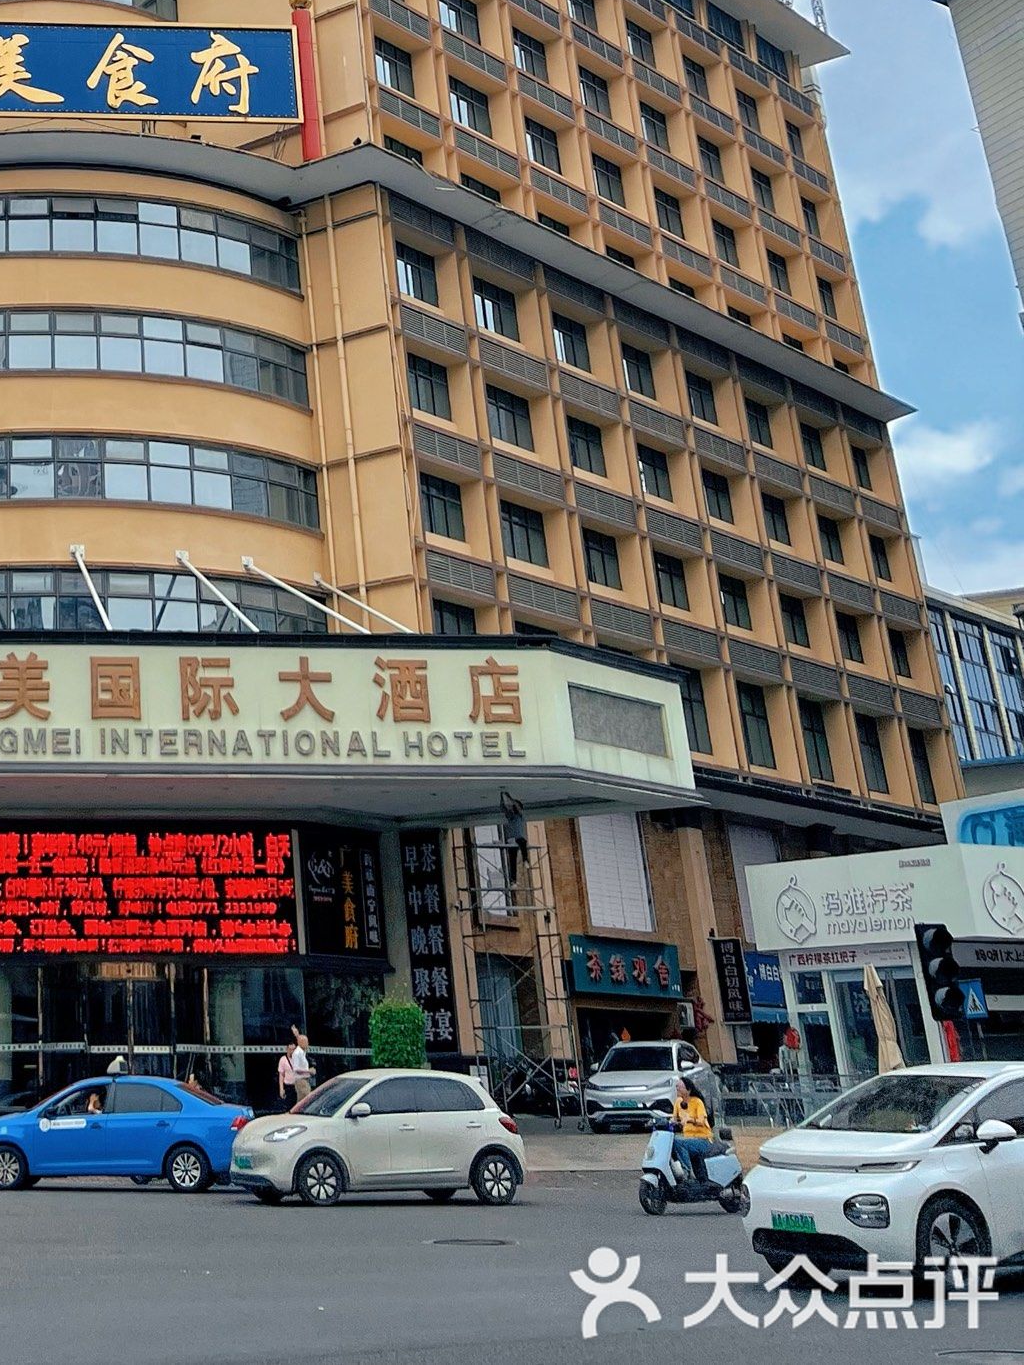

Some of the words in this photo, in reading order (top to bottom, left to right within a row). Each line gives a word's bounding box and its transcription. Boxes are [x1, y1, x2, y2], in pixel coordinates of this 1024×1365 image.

[99, 727, 391, 758] INTERNATIONAL
[404, 729, 526, 758] HOTEL
[404, 843, 437, 874] 早茶
[407, 884, 441, 915] 中餐
[410, 924, 445, 957] 晚餐
